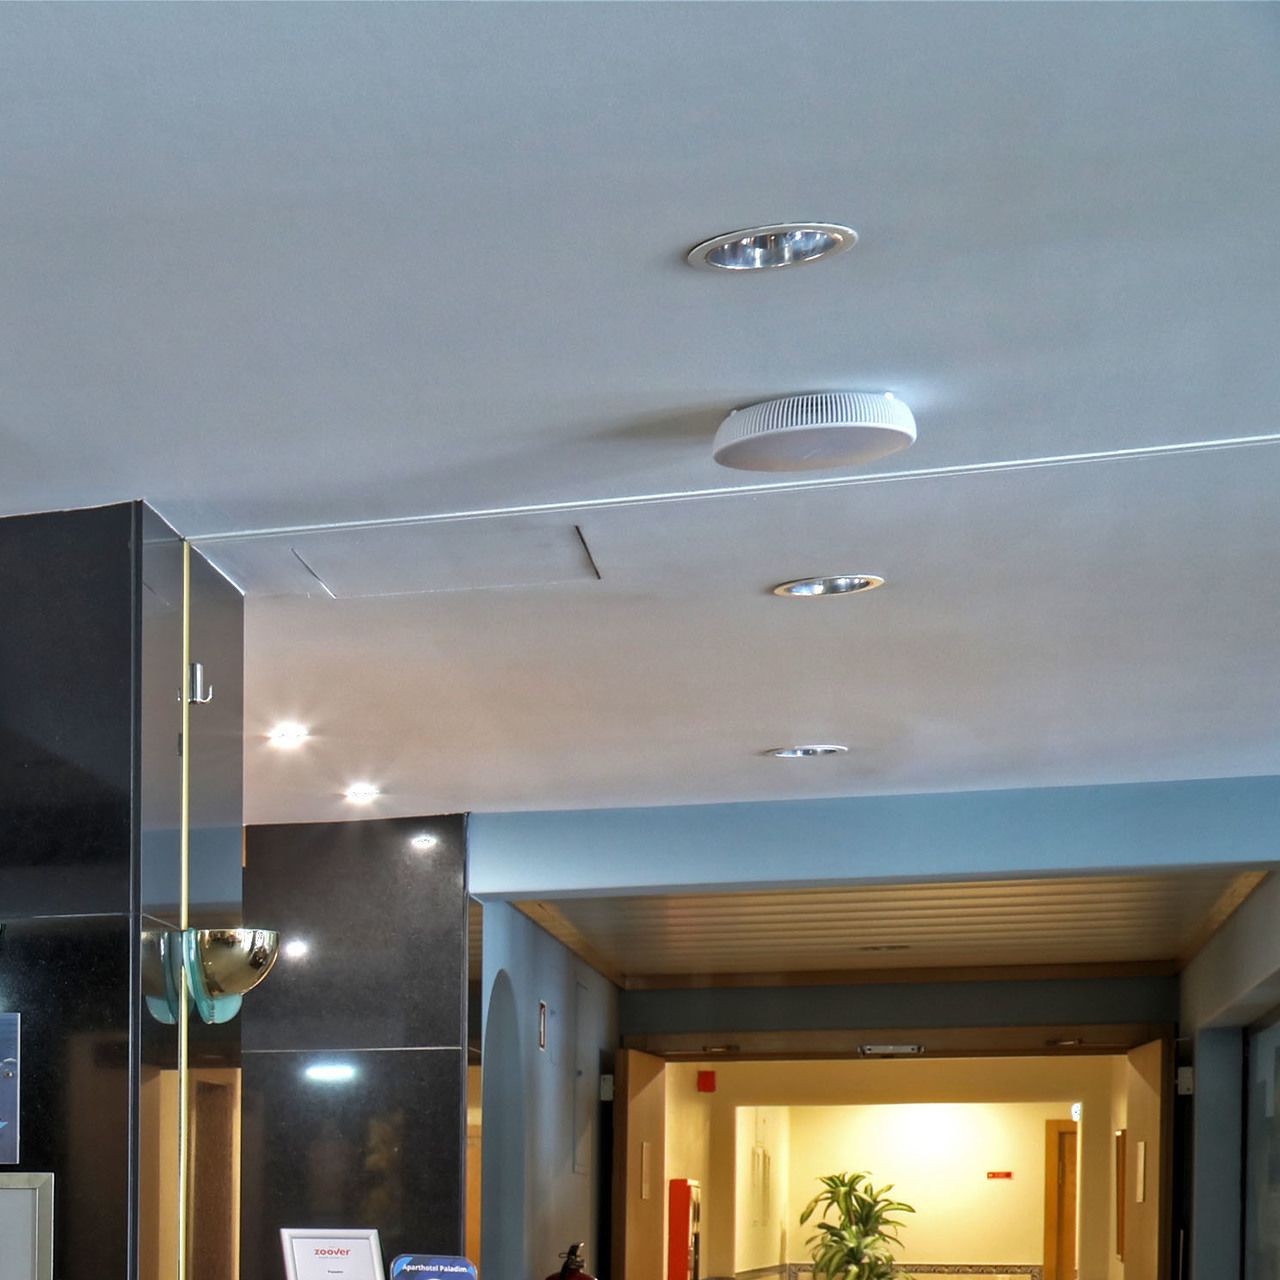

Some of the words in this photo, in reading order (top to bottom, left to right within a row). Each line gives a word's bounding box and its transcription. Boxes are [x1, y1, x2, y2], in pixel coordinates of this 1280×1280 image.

[314, 1248, 352, 1256] zoover
[402, 1263, 438, 1273] Aparthotel
[440, 1264, 468, 1273] Paladim
